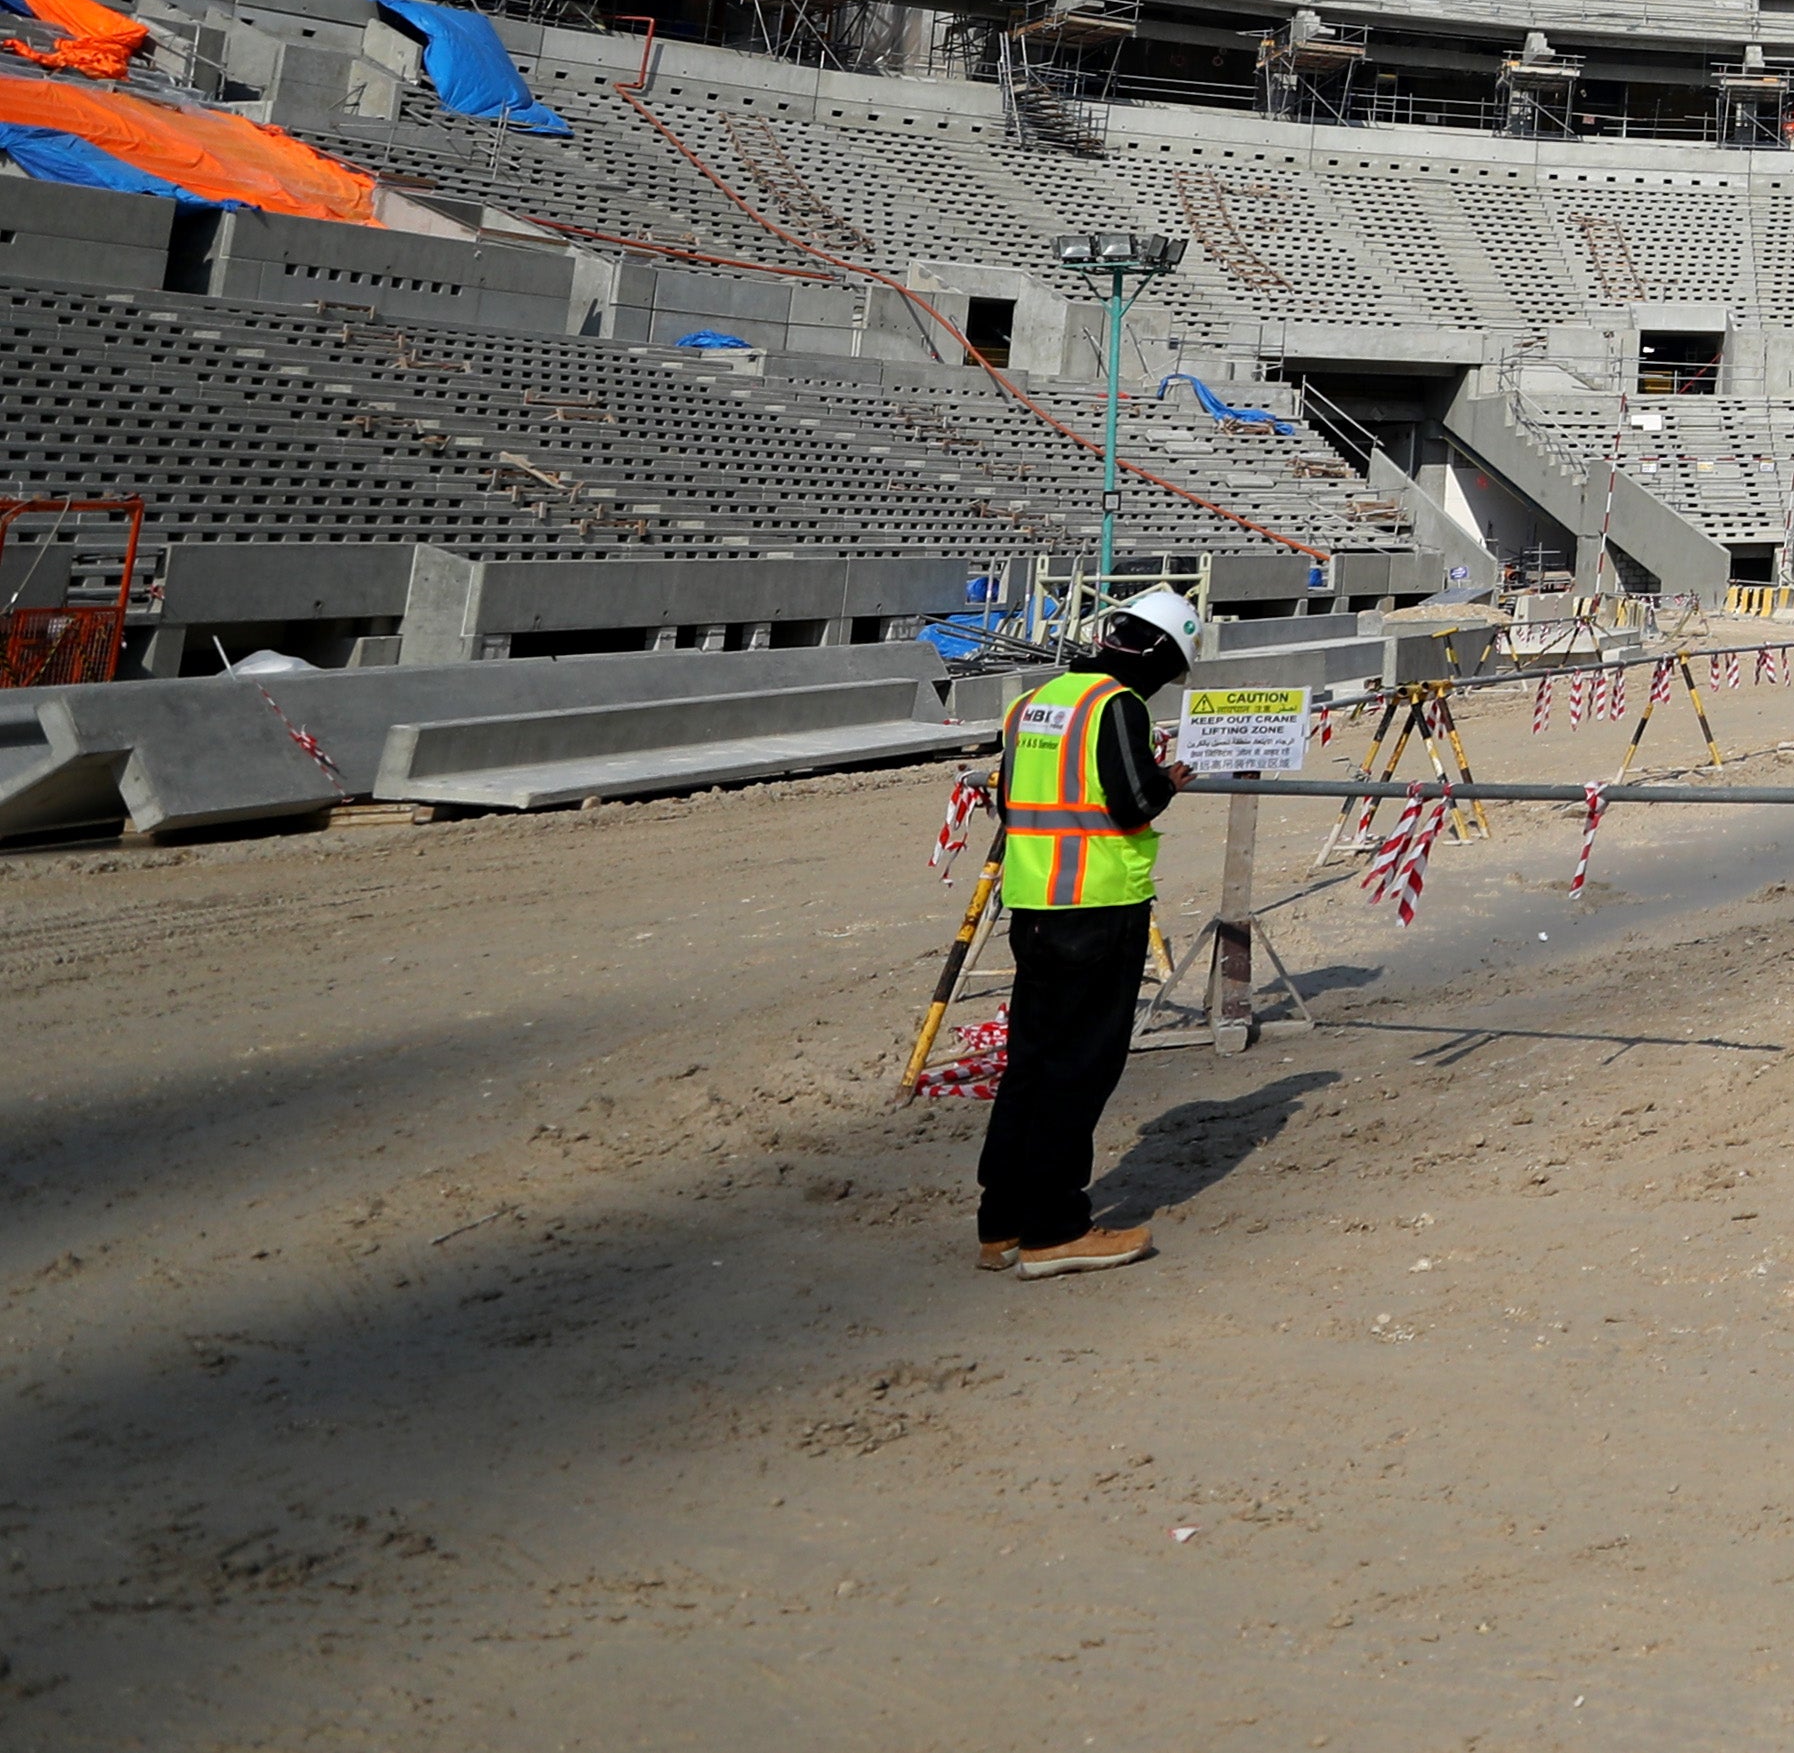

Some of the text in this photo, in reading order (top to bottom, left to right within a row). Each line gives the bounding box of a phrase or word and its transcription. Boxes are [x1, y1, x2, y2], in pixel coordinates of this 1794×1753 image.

[1227, 692, 1289, 704] CAUTION
[1191, 715, 1298, 725] KEEP OUT CRANE
[1202, 726, 1285, 735] LIFTING ZONE
